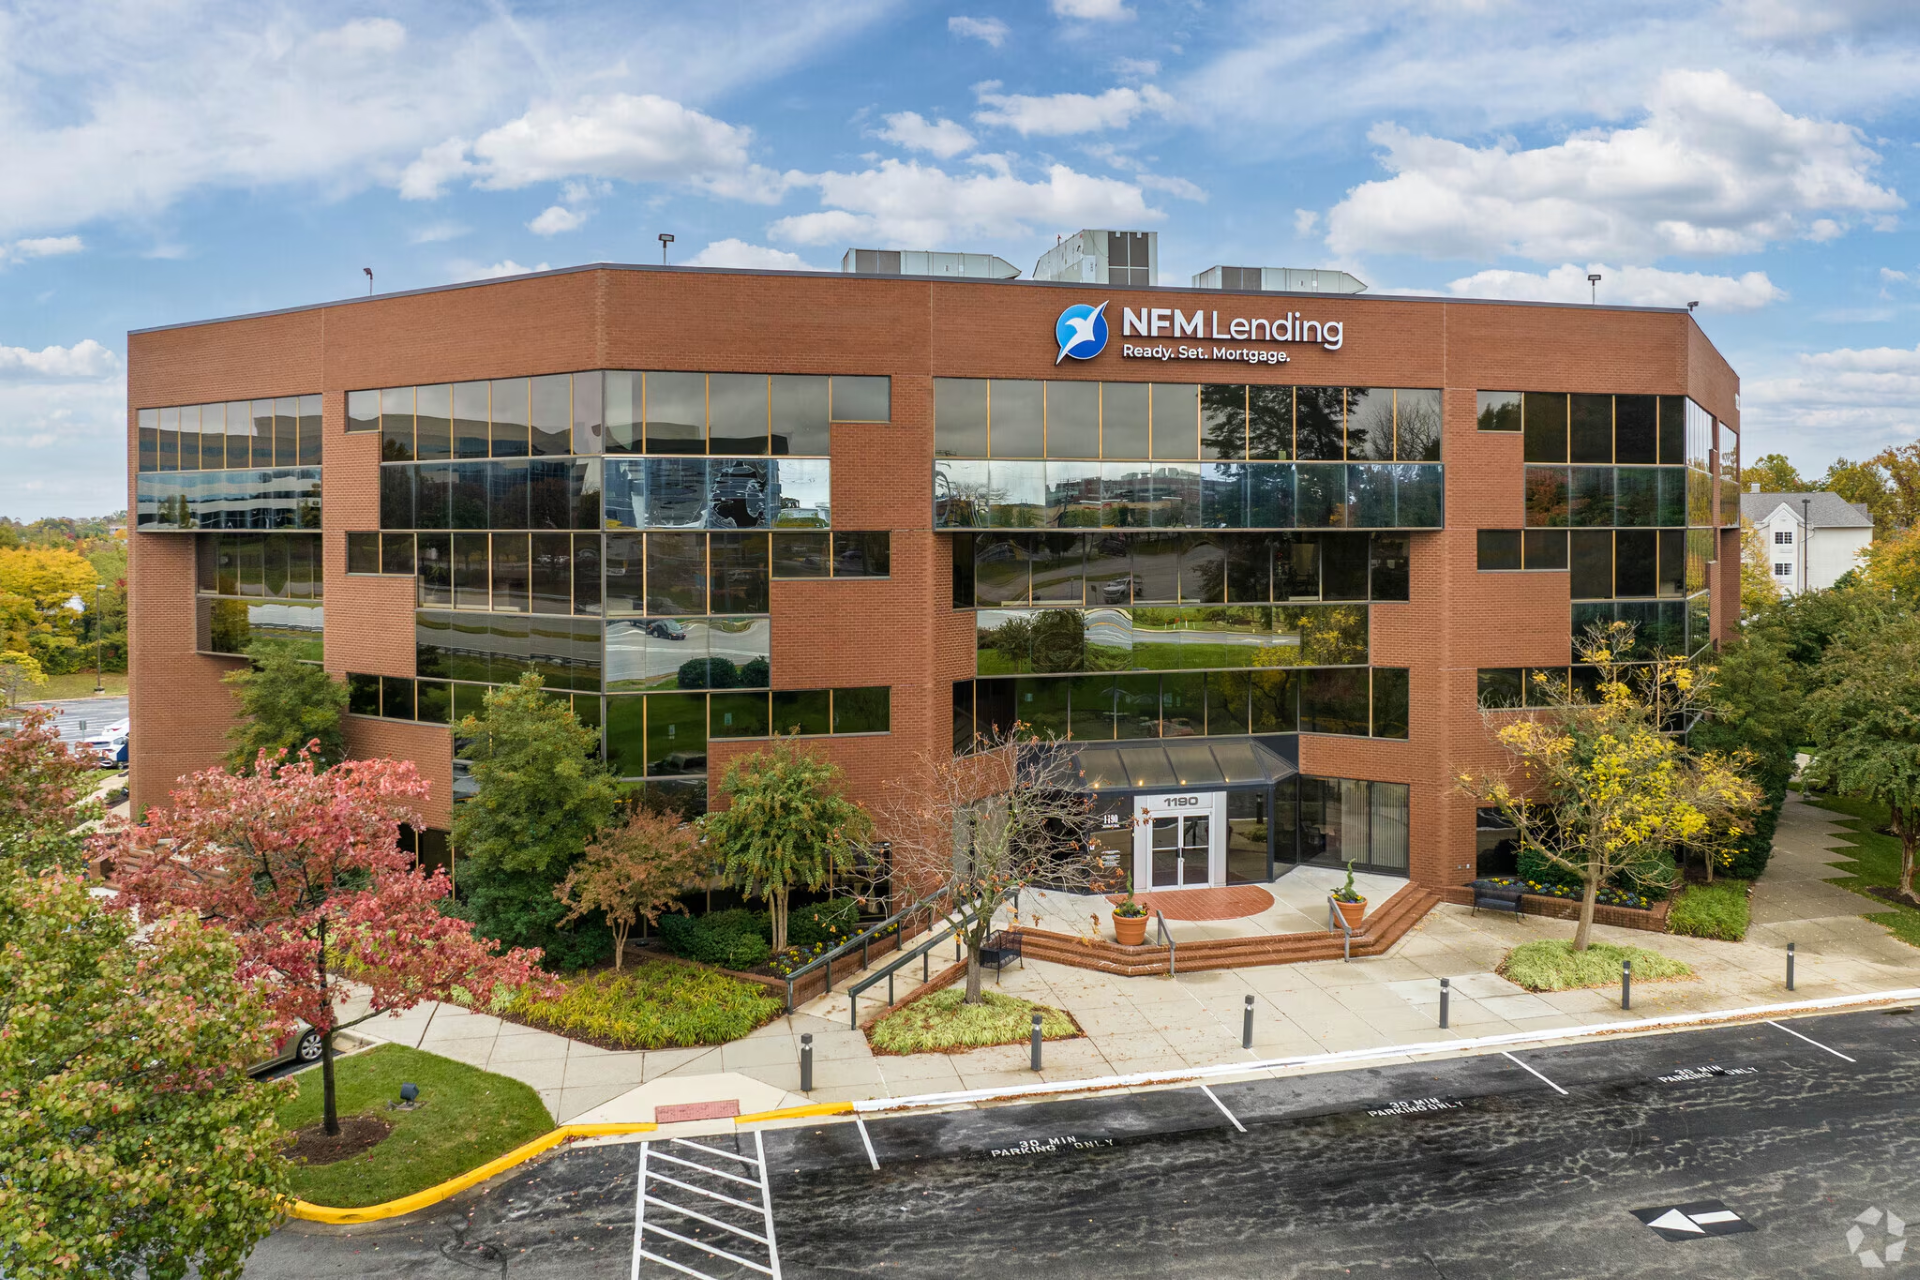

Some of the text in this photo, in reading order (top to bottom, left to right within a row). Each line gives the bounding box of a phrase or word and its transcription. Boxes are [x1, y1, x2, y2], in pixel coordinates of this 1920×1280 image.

[1122, 306, 1344, 351] NFM Lending
[1123, 344, 1291, 364] Ready. Set. Mortgage.
[1163, 796, 1199, 807] 1190
[1658, 1066, 1759, 1083] PARKING ONLY
[1368, 1101, 1464, 1117] PARKING ONLY
[1412, 1097, 1440, 1105] MIN
[991, 1139, 1114, 1157] PARKING ONLY
[1019, 1135, 1077, 1148] 30 MIN
